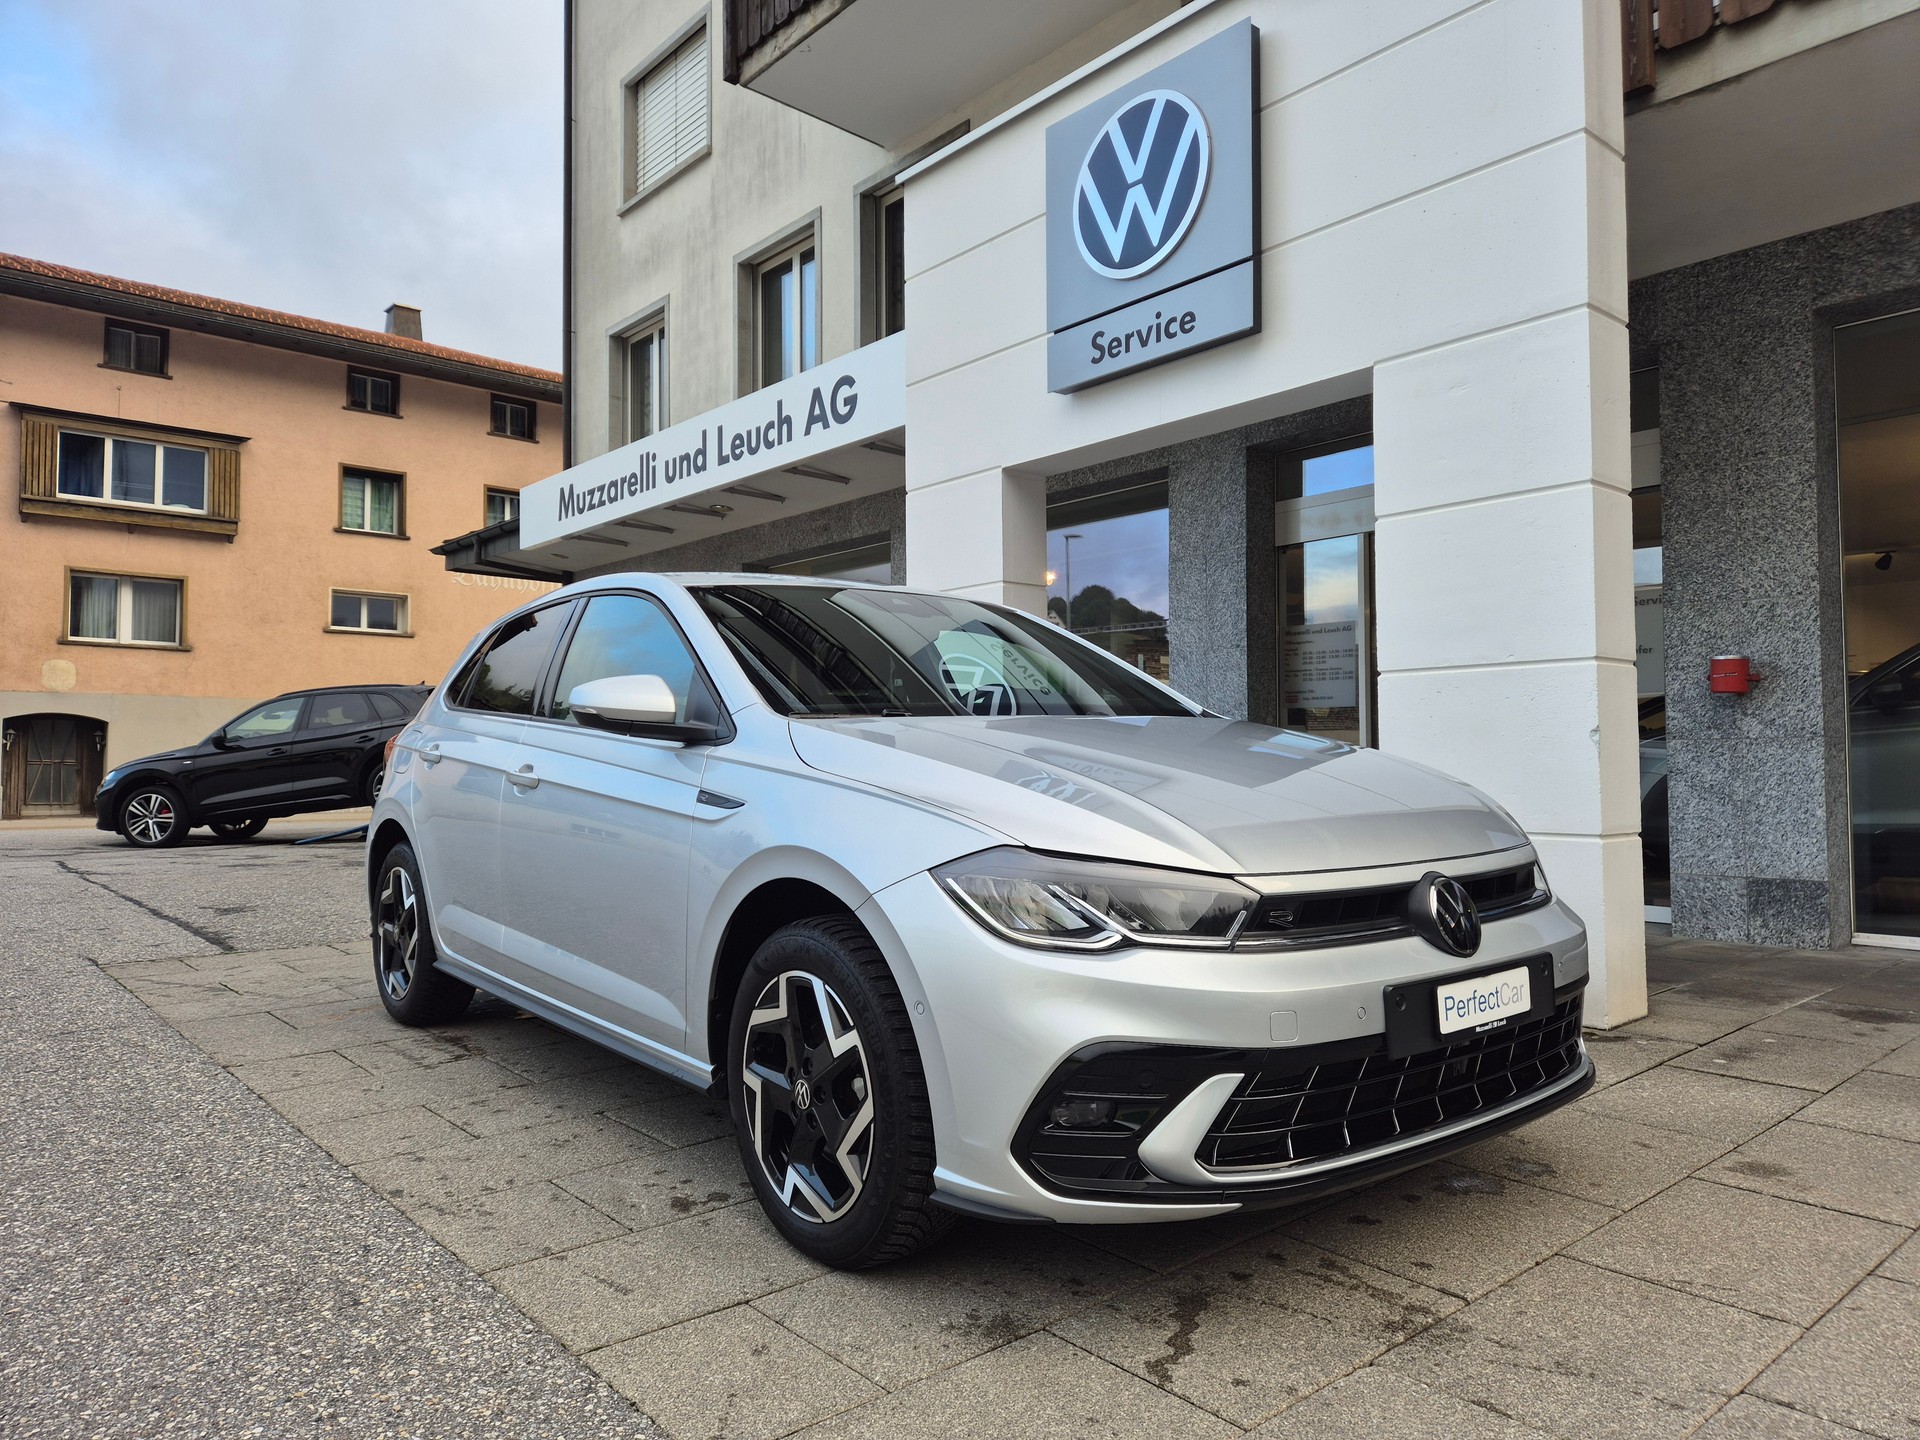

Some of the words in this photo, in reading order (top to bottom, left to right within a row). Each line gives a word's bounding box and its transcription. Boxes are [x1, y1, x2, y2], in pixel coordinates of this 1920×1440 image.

[1090, 310, 1197, 365] Service
[557, 452, 657, 522] Muzzarelli
[663, 429, 708, 484] und
[716, 399, 793, 466] Leuch
[803, 374, 859, 437] AG
[1443, 982, 1524, 1022] PerfectCar
